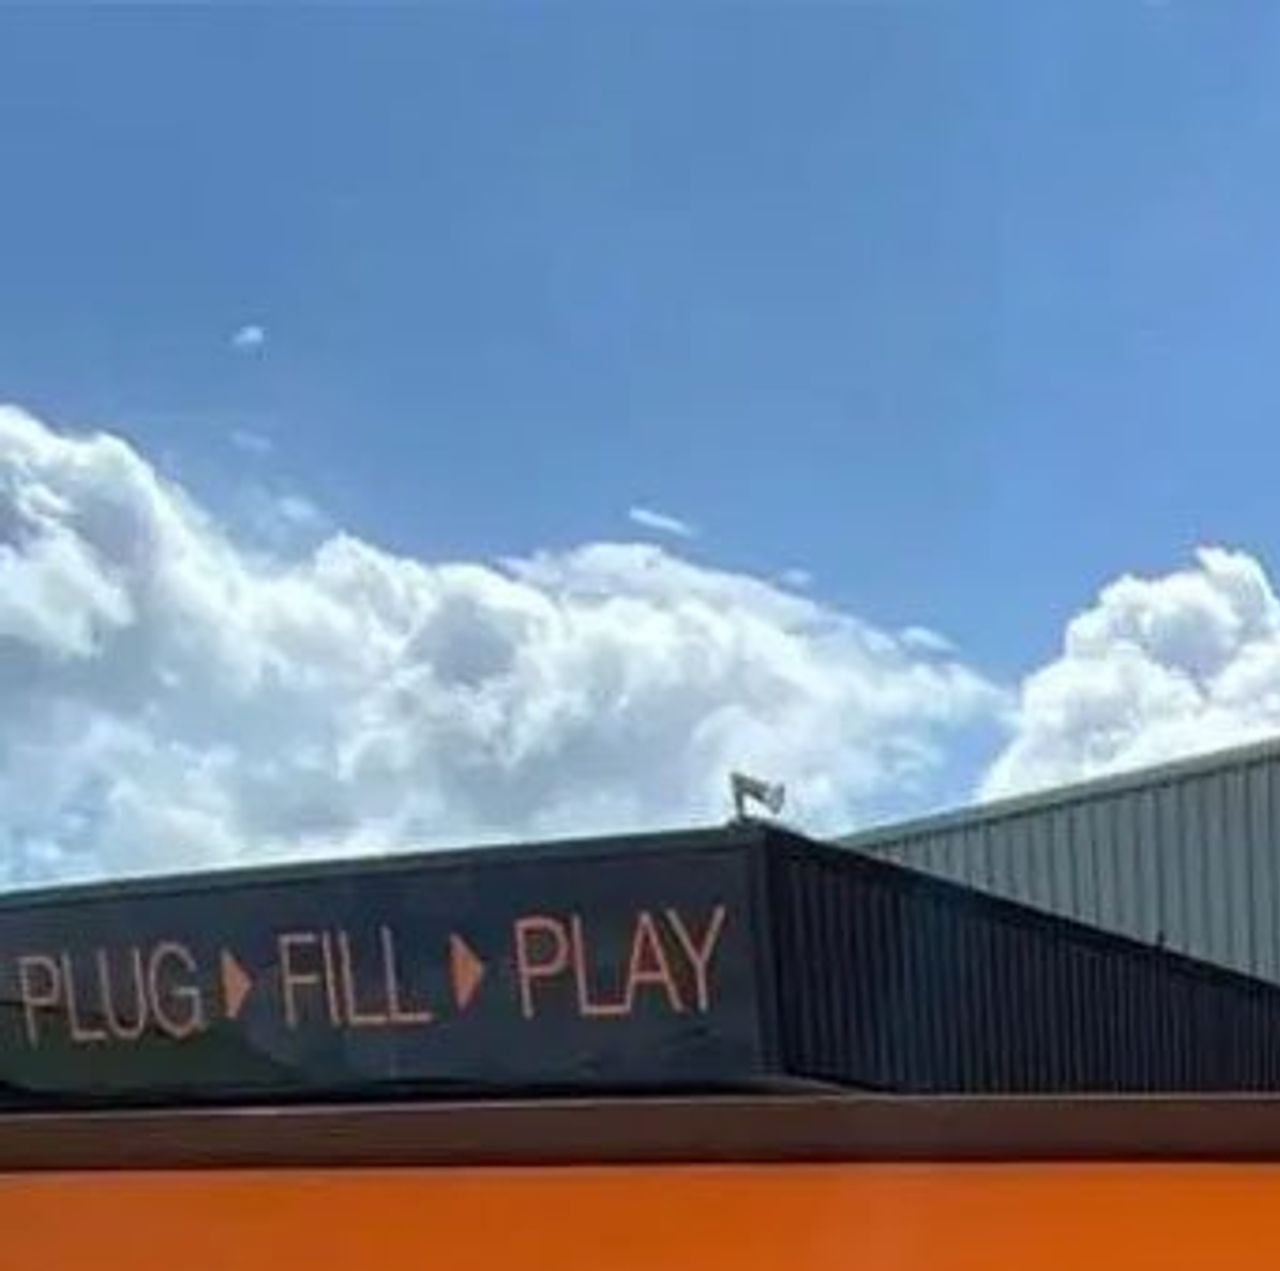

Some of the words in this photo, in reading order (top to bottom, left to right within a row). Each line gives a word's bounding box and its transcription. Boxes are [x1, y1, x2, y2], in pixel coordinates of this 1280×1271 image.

[18, 940, 206, 1047] PLUG
[279, 925, 432, 1026] FILL
[514, 905, 726, 1018] PLAY
